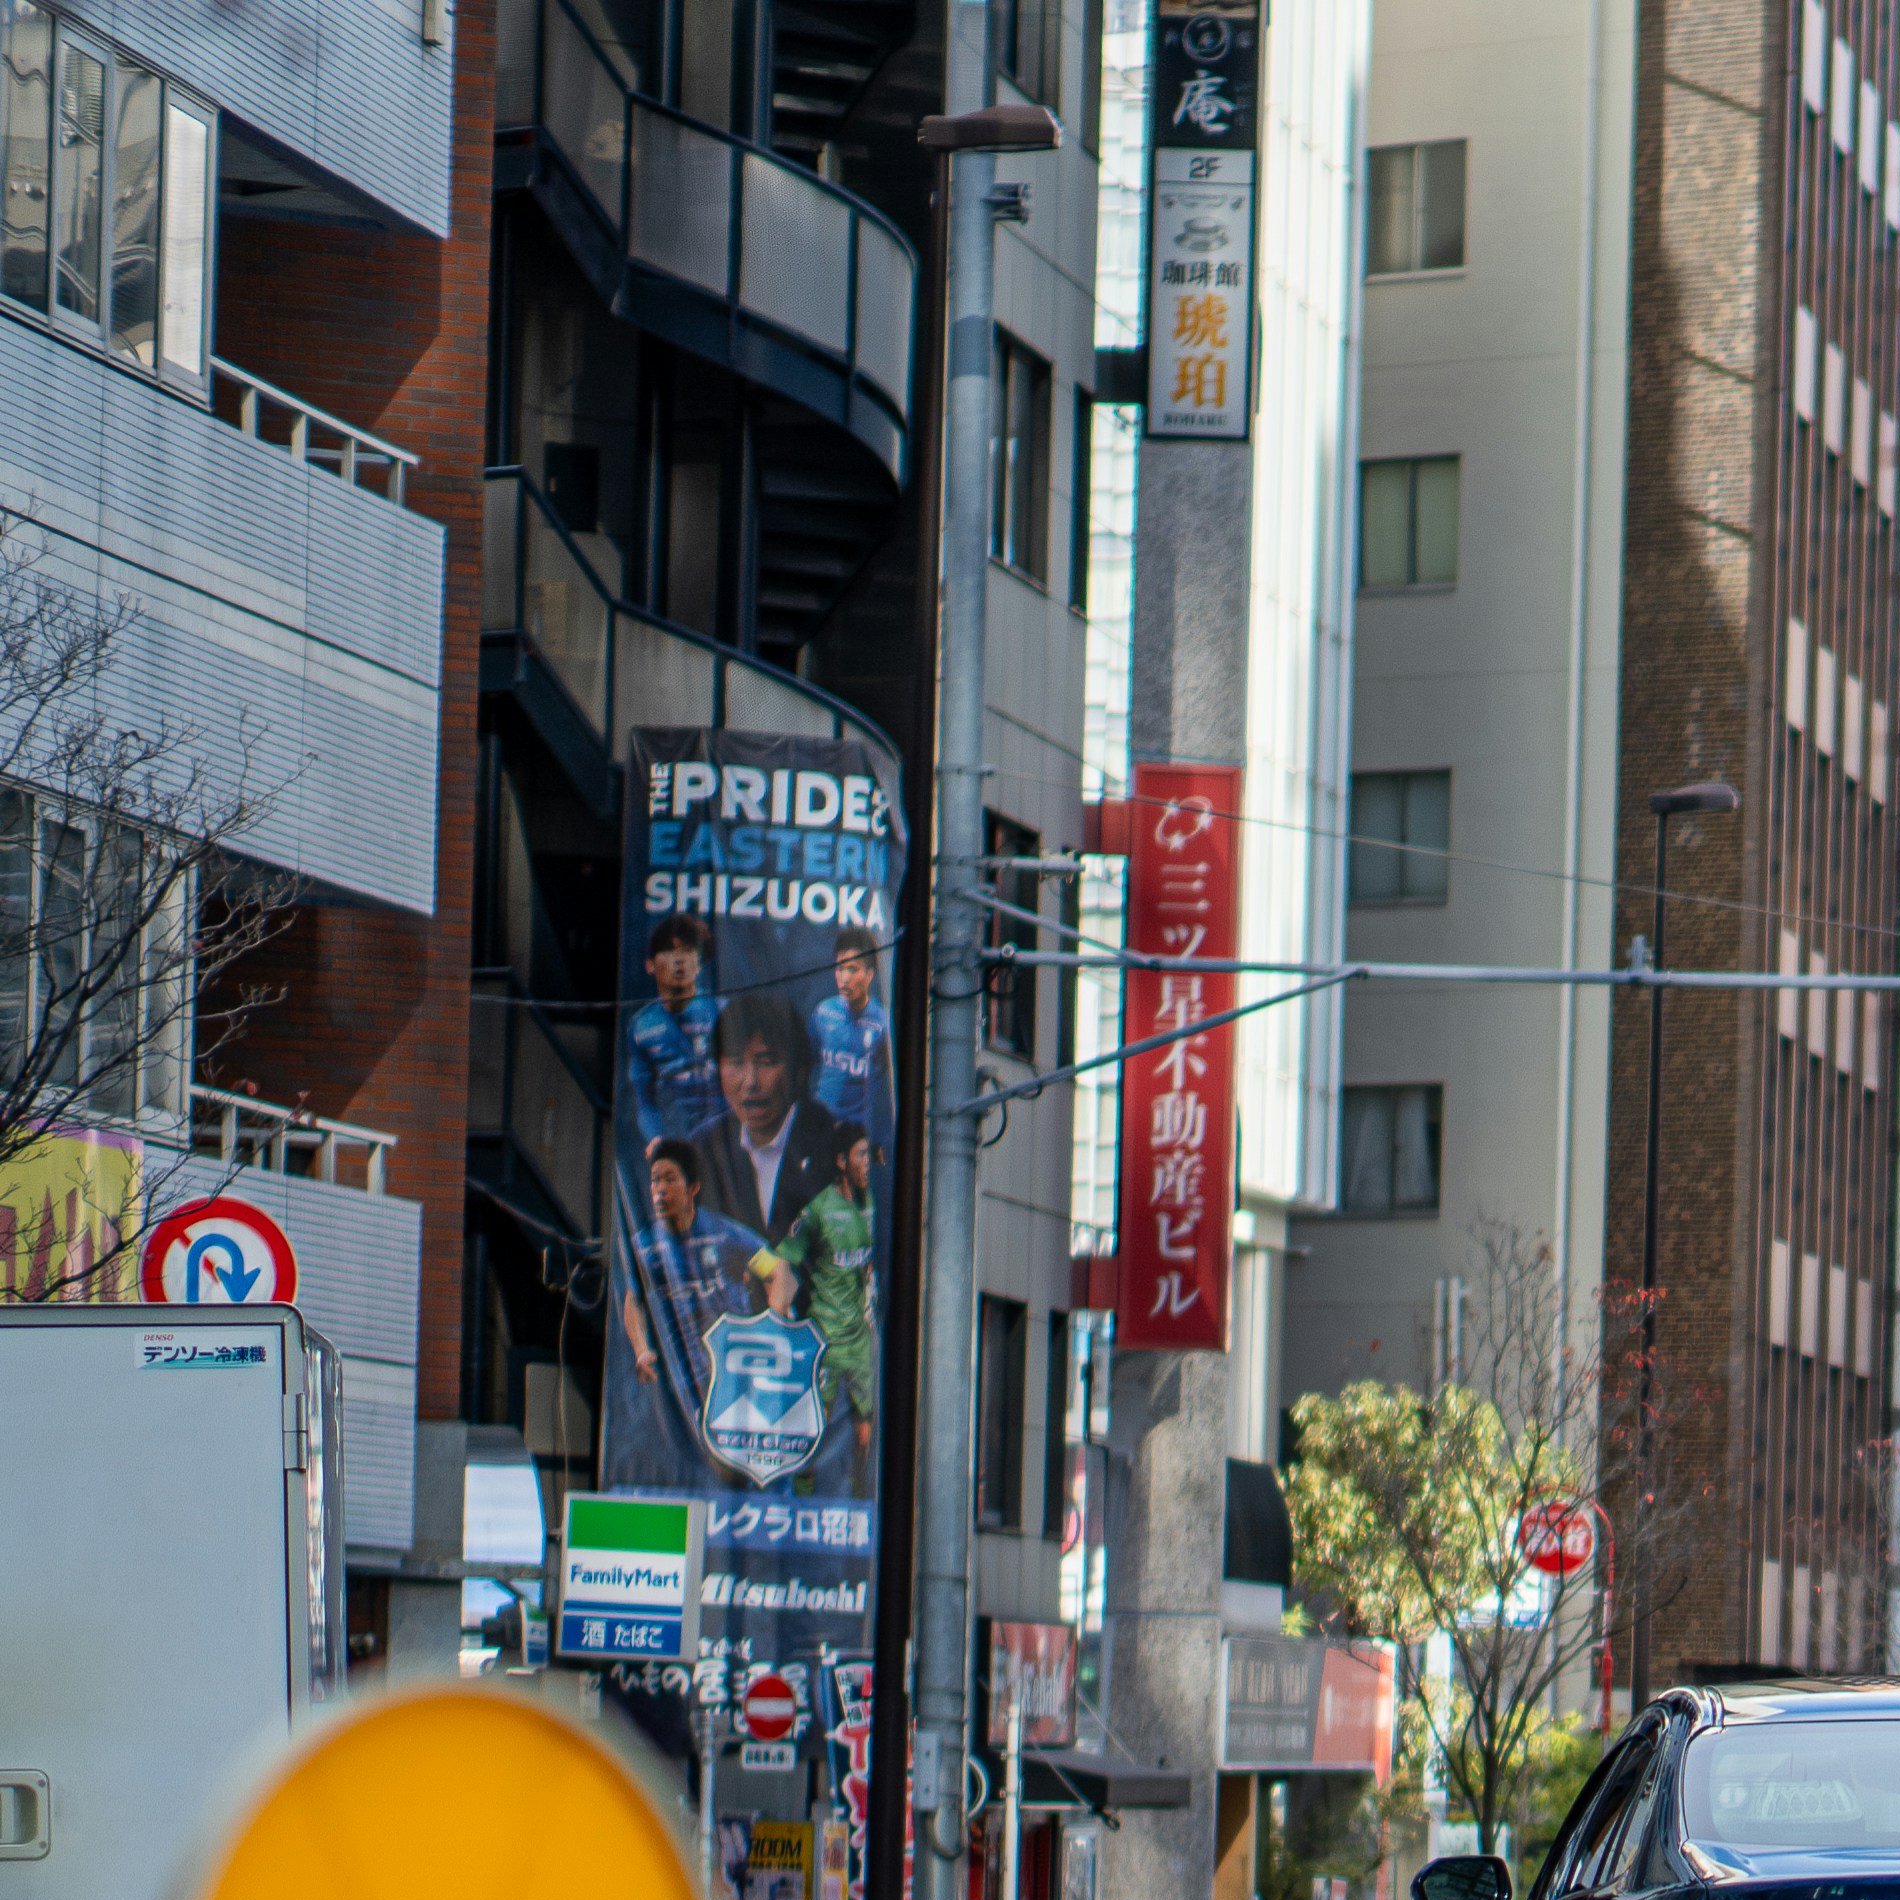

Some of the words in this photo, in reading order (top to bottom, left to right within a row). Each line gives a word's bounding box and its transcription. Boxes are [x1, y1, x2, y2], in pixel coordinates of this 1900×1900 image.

[1189, 156, 1223, 180] 2F
[1171, 292, 1229, 408] 琥珀
[651, 762, 671, 817] THE
[673, 761, 874, 833] PRIDE
[650, 820, 889, 886] EASTERN
[645, 871, 884, 931] SHIZUOKA
[1149, 862, 1211, 1319] 三ツ星不動産ビル
[144, 1334, 174, 1342] DENSO
[570, 1564, 679, 1589] FamilyMart
[581, 1618, 605, 1648] 酒
[614, 1622, 663, 1648] たばこ
